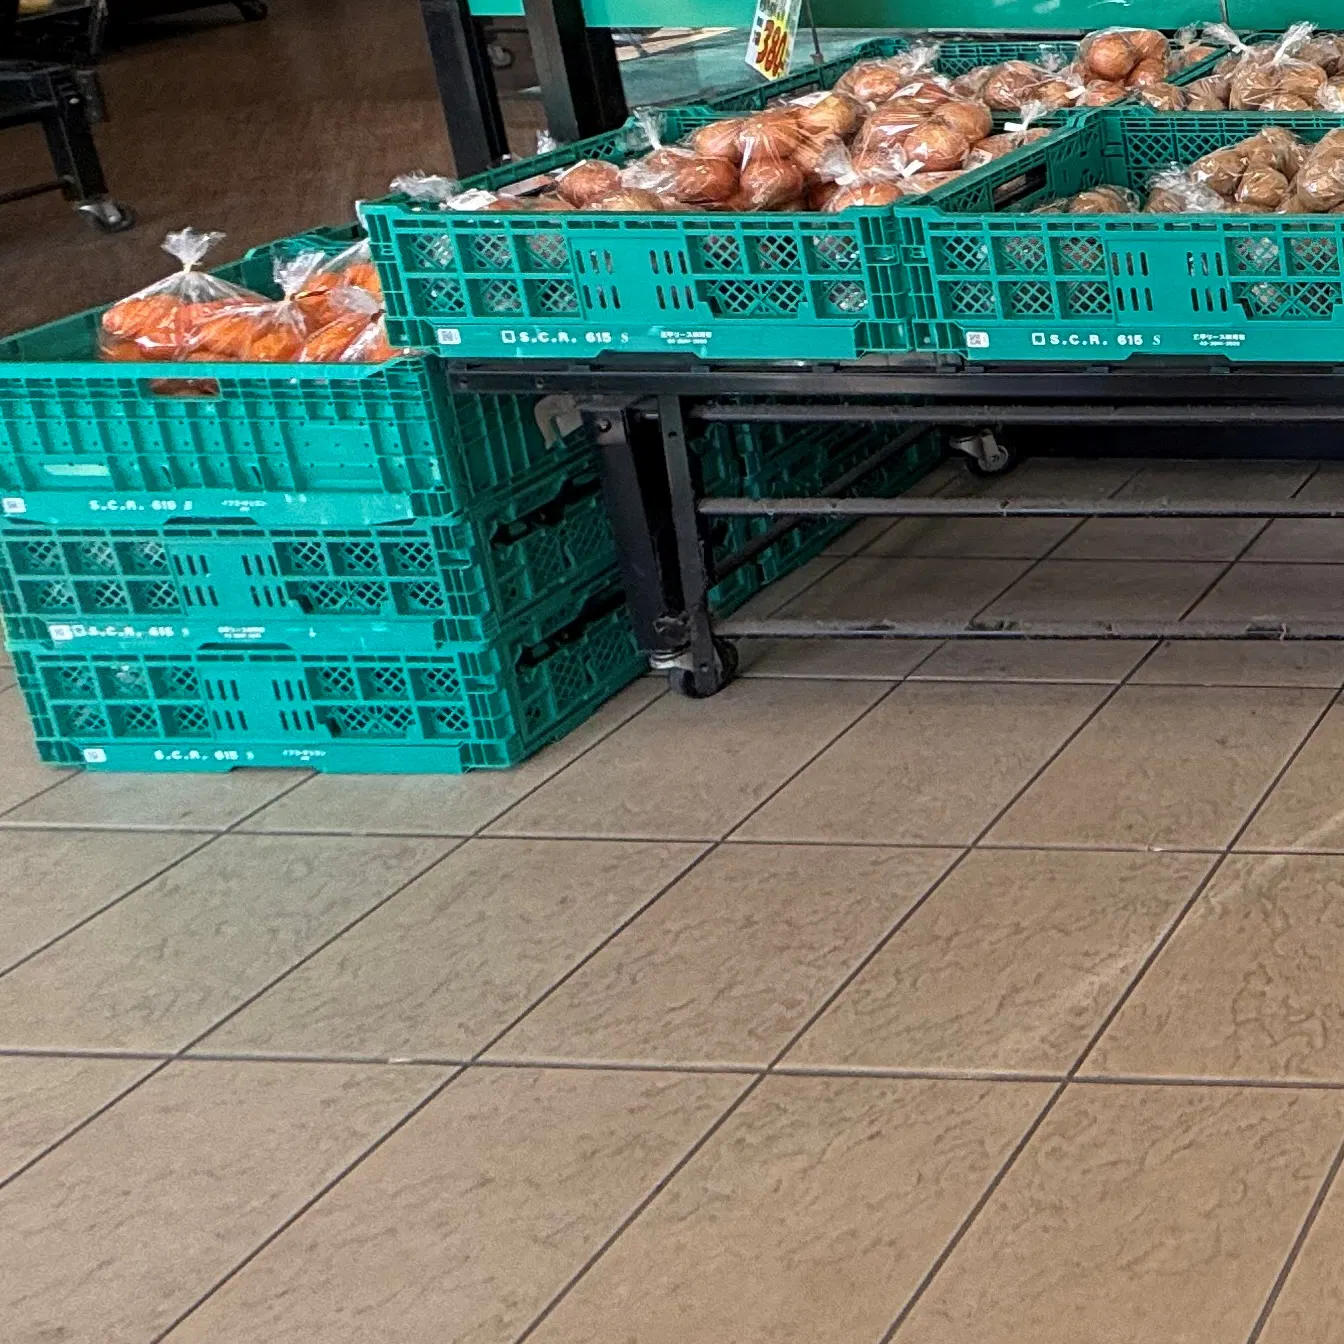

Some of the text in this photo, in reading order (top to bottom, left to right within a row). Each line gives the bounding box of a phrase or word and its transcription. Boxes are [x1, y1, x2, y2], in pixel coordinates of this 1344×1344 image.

[519, 331, 577, 344] S.C.R.
[585, 331, 613, 344] 615
[1050, 333, 1108, 346] S.C.R.
[1117, 334, 1144, 346] 615
